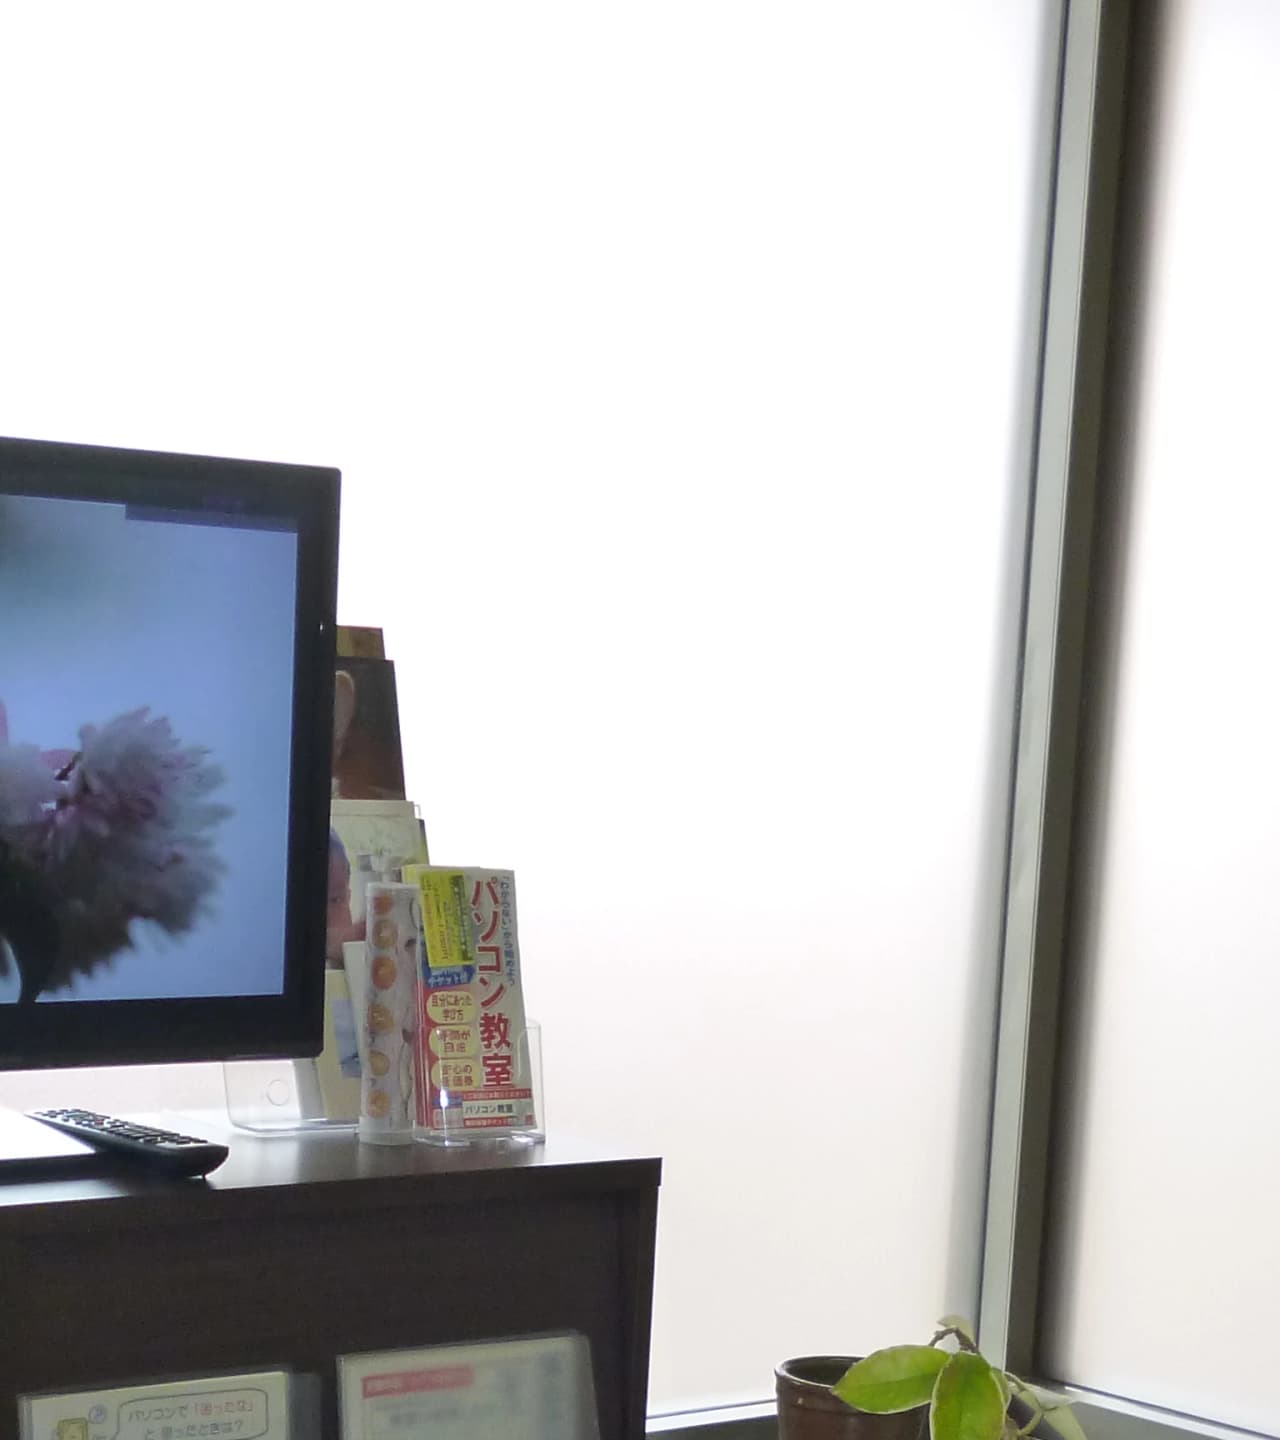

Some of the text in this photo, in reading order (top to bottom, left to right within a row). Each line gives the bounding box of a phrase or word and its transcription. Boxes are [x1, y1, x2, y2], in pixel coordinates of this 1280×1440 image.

[471, 874, 514, 1089] パソコン教室
[464, 1103, 514, 1114] パソコン教室
